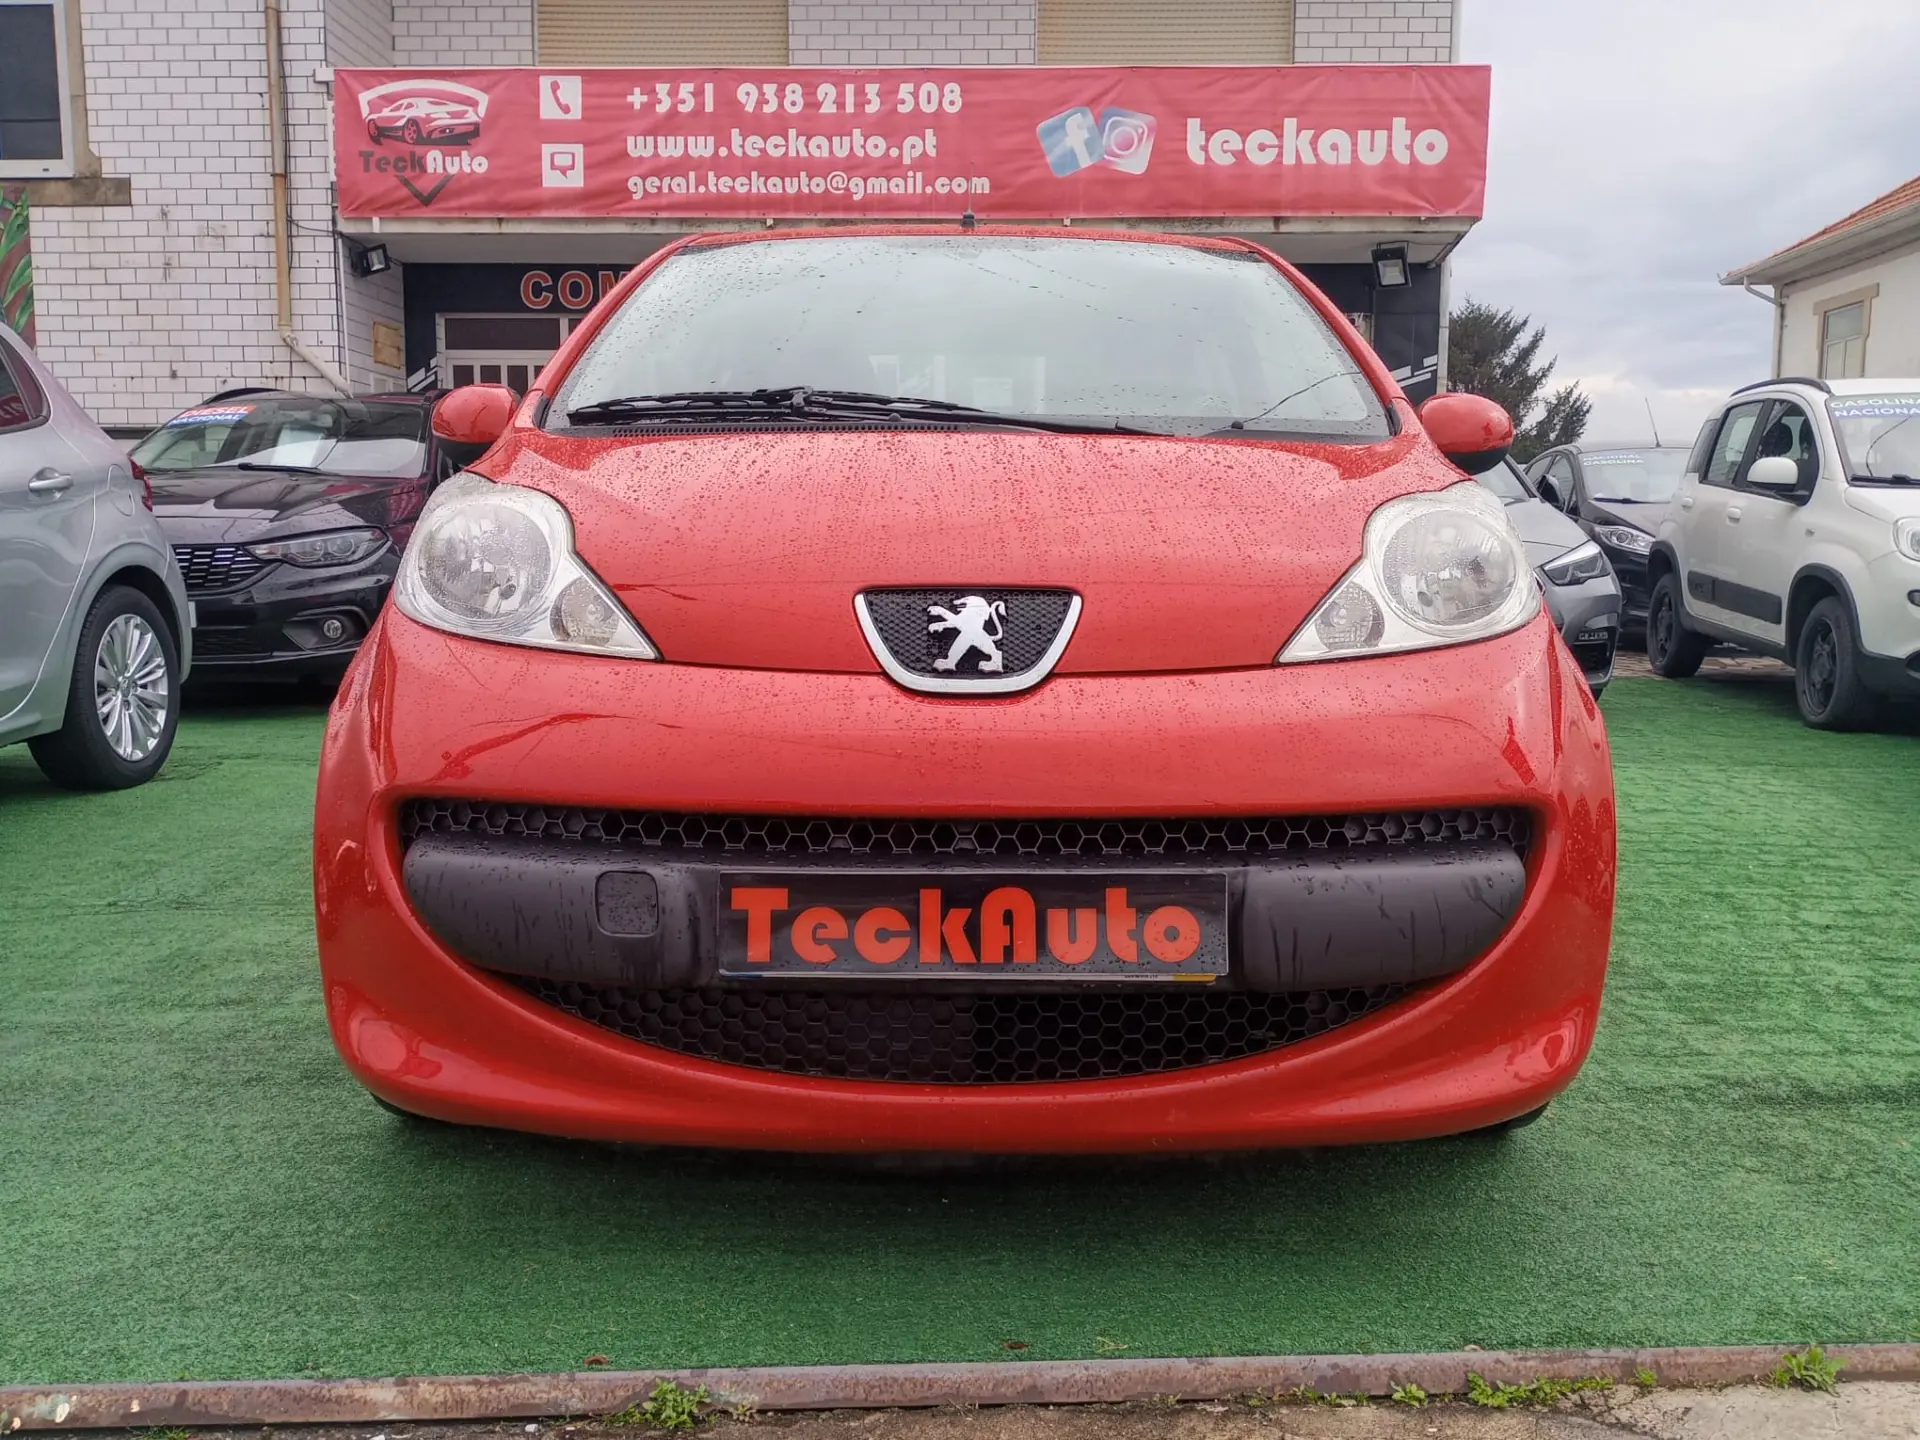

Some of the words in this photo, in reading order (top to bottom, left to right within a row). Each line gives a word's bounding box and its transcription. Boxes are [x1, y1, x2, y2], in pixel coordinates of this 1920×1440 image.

[626, 82, 715, 113] +351
[736, 83, 804, 113] 938
[816, 83, 881, 113] 213
[896, 82, 963, 114] 508
[626, 128, 938, 164] www.teckauto.pt
[1186, 117, 1448, 165] teckauto
[358, 149, 489, 174] TeckAuto
[627, 170, 991, 200] geral.teckauto@gmail.com
[730, 886, 1201, 965] TeckAuto
